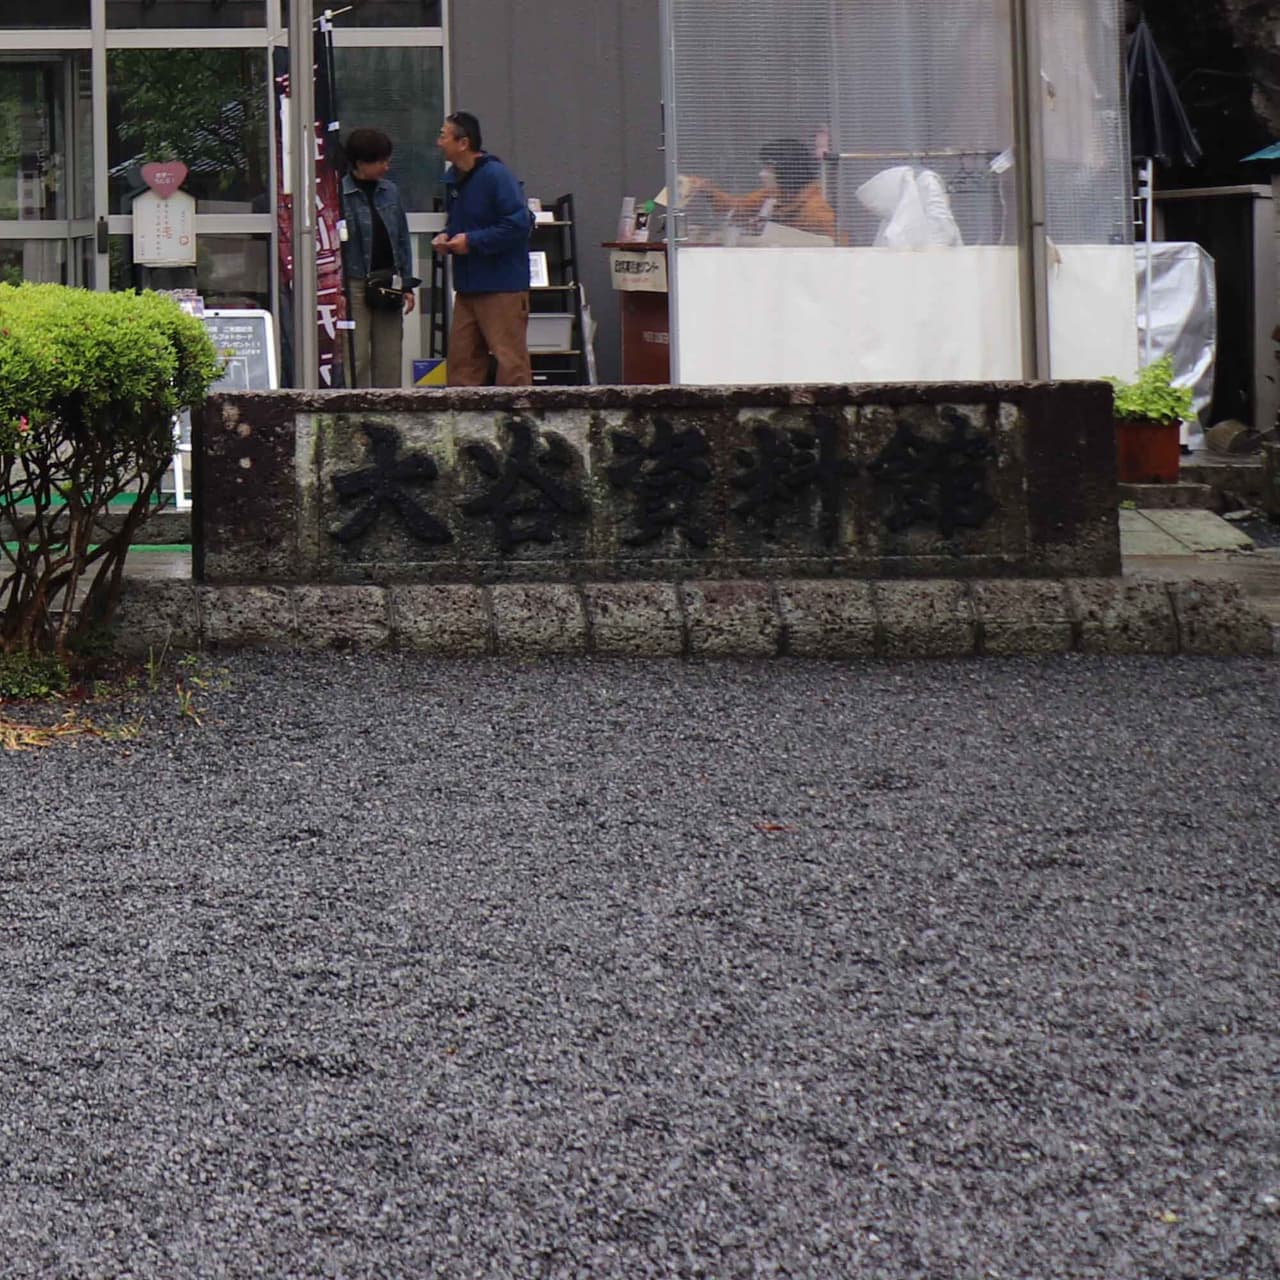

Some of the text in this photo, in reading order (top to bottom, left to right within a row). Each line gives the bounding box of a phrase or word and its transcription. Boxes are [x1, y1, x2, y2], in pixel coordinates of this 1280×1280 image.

[328, 407, 1001, 551] 大谷資料館
